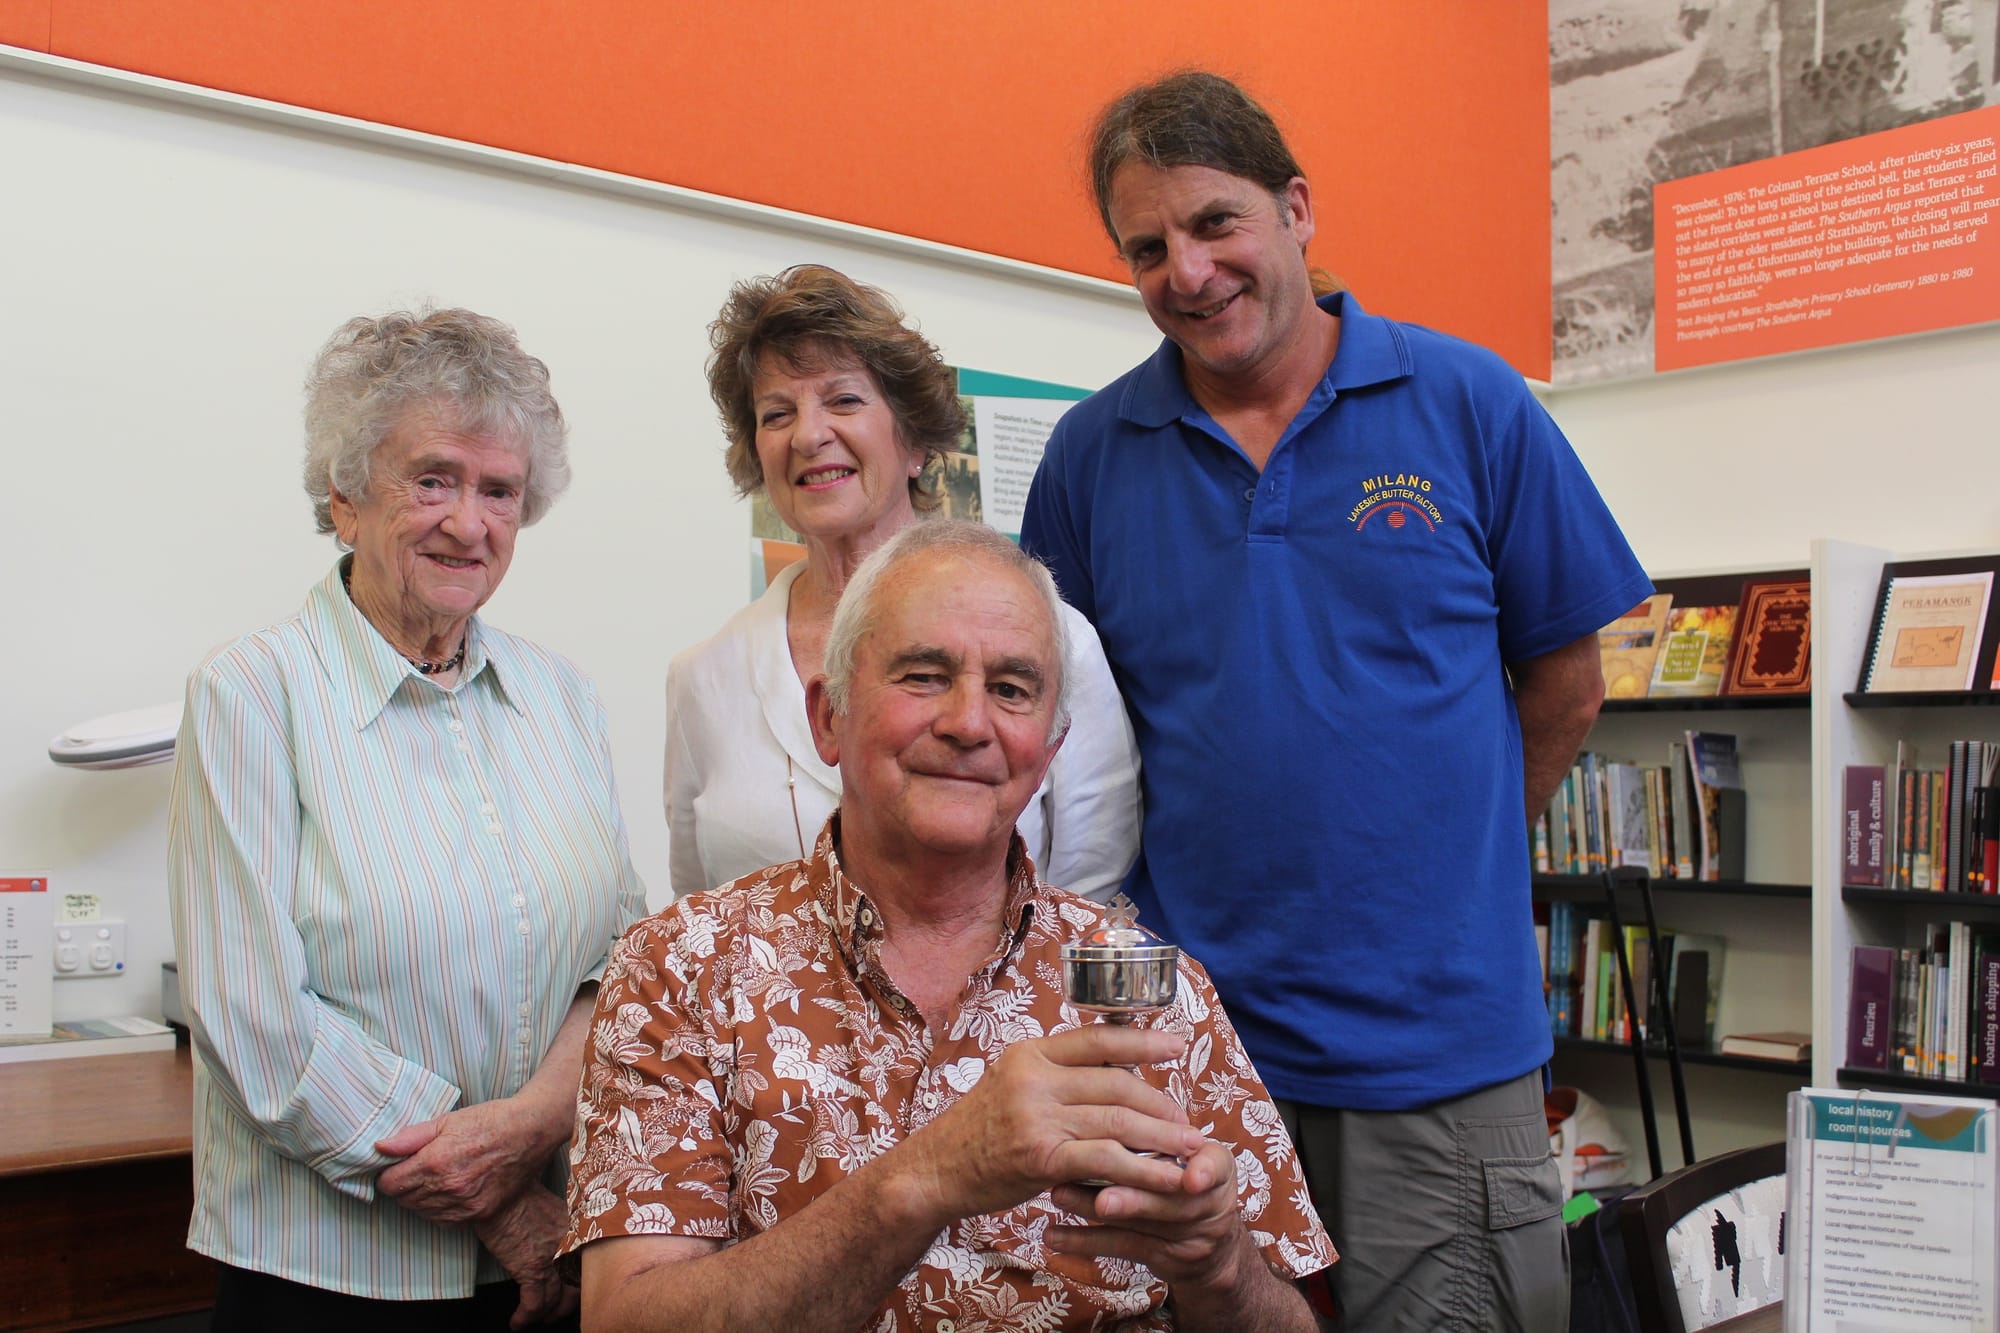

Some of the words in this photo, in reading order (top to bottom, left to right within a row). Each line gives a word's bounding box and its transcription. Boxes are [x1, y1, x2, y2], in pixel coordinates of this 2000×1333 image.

[1676, 218, 1692, 228] was
[1727, 207, 1738, 217] To
[1740, 203, 1756, 214] the
[1758, 200, 1778, 211] long
[1780, 192, 1810, 206] tolling
[1814, 186, 1824, 198] of
[1826, 184, 1842, 196] the
[1845, 176, 1875, 192] school
[1903, 167, 1920, 178] the
[1923, 158, 1968, 175] students
[1972, 149, 1996, 164] filed
[1748, 187, 1765, 198] The
[1768, 181, 1802, 194] Colman
[1805, 172, 1839, 186] Terrace
[1880, 156, 1904, 170] after
[1908, 144, 1960, 163] ninety-six
[1676, 231, 1690, 242] out
[1693, 226, 1708, 238] the
[1710, 222, 1732, 235] front
[1735, 218, 1755, 230] door
[1758, 214, 1778, 224] onto
[1781, 212, 1786, 220] a
[1789, 203, 1818, 218] school
[1822, 201, 1838, 211] bus
[1841, 189, 1883, 208] destined
[1886, 188, 1900, 198] for
[1903, 182, 1924, 194] East
[1928, 174, 1965, 189] Terrace
[1976, 165, 1996, 179] and
[1676, 244, 1692, 256] the
[1721, 232, 1760, 246] corridors
[1763, 226, 1785, 238] were
[1819, 215, 1836, 227] The
[1838, 206, 1880, 223] Southern
[1883, 200, 1912, 214] Argus
[1914, 188, 1958, 208] reported
[1962, 184, 1984, 198] that
[1676, 272, 1692, 284] the
[1693, 266, 1710, 280] end
[1712, 264, 1722, 276] of
[1724, 265, 1736, 274] an
[1758, 247, 1824, 267] Unfortunately
[1826, 243, 1842, 254] the
[1896, 226, 1927, 240] which
[1930, 220, 1950, 234] had
[1953, 213, 1988, 230] served
[1689, 254, 1714, 267] many
[1717, 250, 1726, 262] of
[1728, 248, 1744, 260] the
[1745, 243, 1768, 256] older
[1771, 236, 1813, 251] residents
[1815, 230, 1825, 242] of
[1892, 215, 1908, 227] the
[1912, 208, 1947, 223] closing
[1950, 201, 1970, 215] will
[1676, 288, 1687, 298] so
[1688, 282, 1714, 296] many
[1715, 281, 1726, 290] so
[1775, 268, 1797, 278] were
[1800, 264, 1812, 274] no
[1814, 258, 1844, 272] longer
[1847, 249, 1892, 265] adequate
[1895, 245, 1908, 256] for
[1912, 242, 1929, 253] the
[1932, 234, 1963, 249] needs
[1966, 230, 1977, 242] of
[1844, 286, 1871, 298] School
[1873, 278, 1914, 293] Centenary
[1918, 274, 1938, 286] 1880
[1940, 272, 1949, 281] to
[1952, 267, 1973, 280] 1980
[1347, 490, 1382, 522] LAKESIDE
[1382, 488, 1414, 500] BUTTER
[1414, 494, 1444, 524] FACTORY
[1362, 474, 1432, 493] MILANG
[1870, 780, 1882, 820] culture
[1848, 809, 1862, 867] aboriginal
[1870, 821, 1881, 831] &
[1868, 836, 1884, 867] family
[1986, 962, 2000, 1012] shipping
[1862, 1002, 1877, 1048] fleurieu
[1984, 1023, 1999, 1066] boating
[1828, 1103, 1854, 1114] local
[1856, 1106, 1894, 1120] history
[1828, 1123, 1856, 1132] room
[1858, 1126, 1912, 1138] resources
